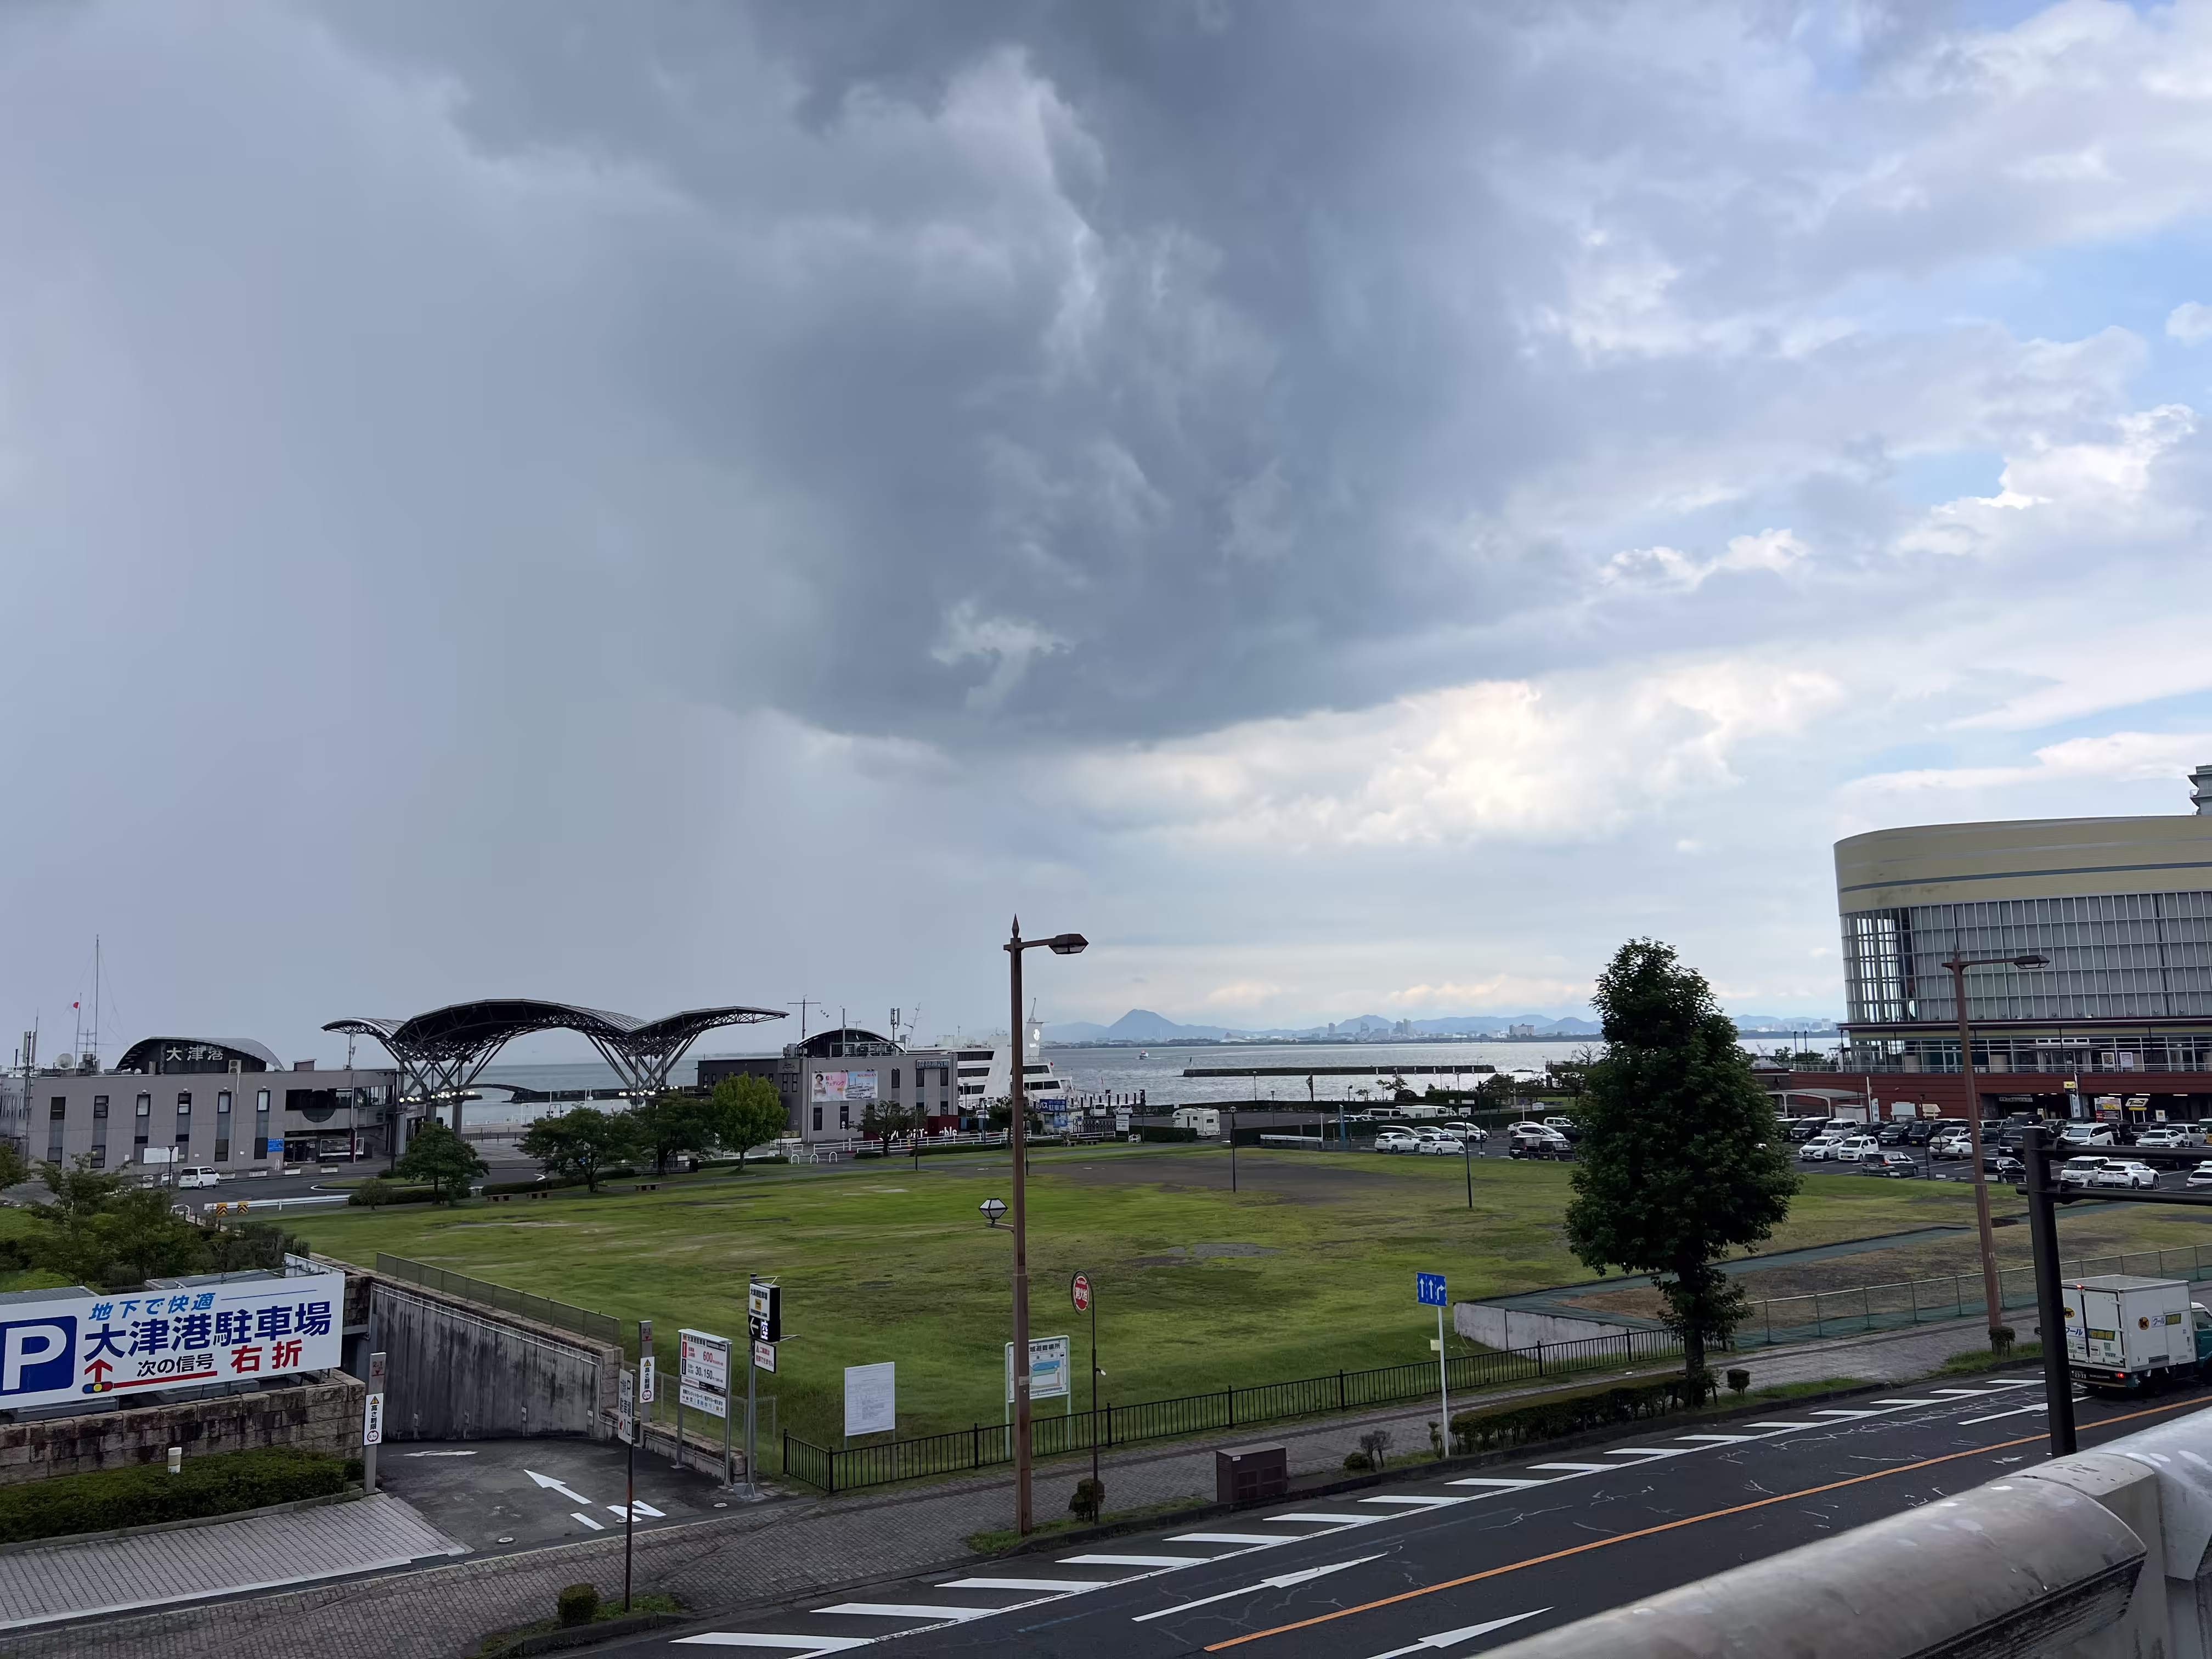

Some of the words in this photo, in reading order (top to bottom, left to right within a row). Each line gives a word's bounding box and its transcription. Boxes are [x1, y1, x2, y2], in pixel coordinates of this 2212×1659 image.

[166, 1046, 223, 1062] 大津港
[88, 1292, 217, 1321] 地下で快適
[83, 1300, 332, 1362] 大津港駐車場
[2, 1324, 67, 1391] P
[136, 1353, 215, 1378] 次の信号
[230, 1338, 303, 1374] 右折
